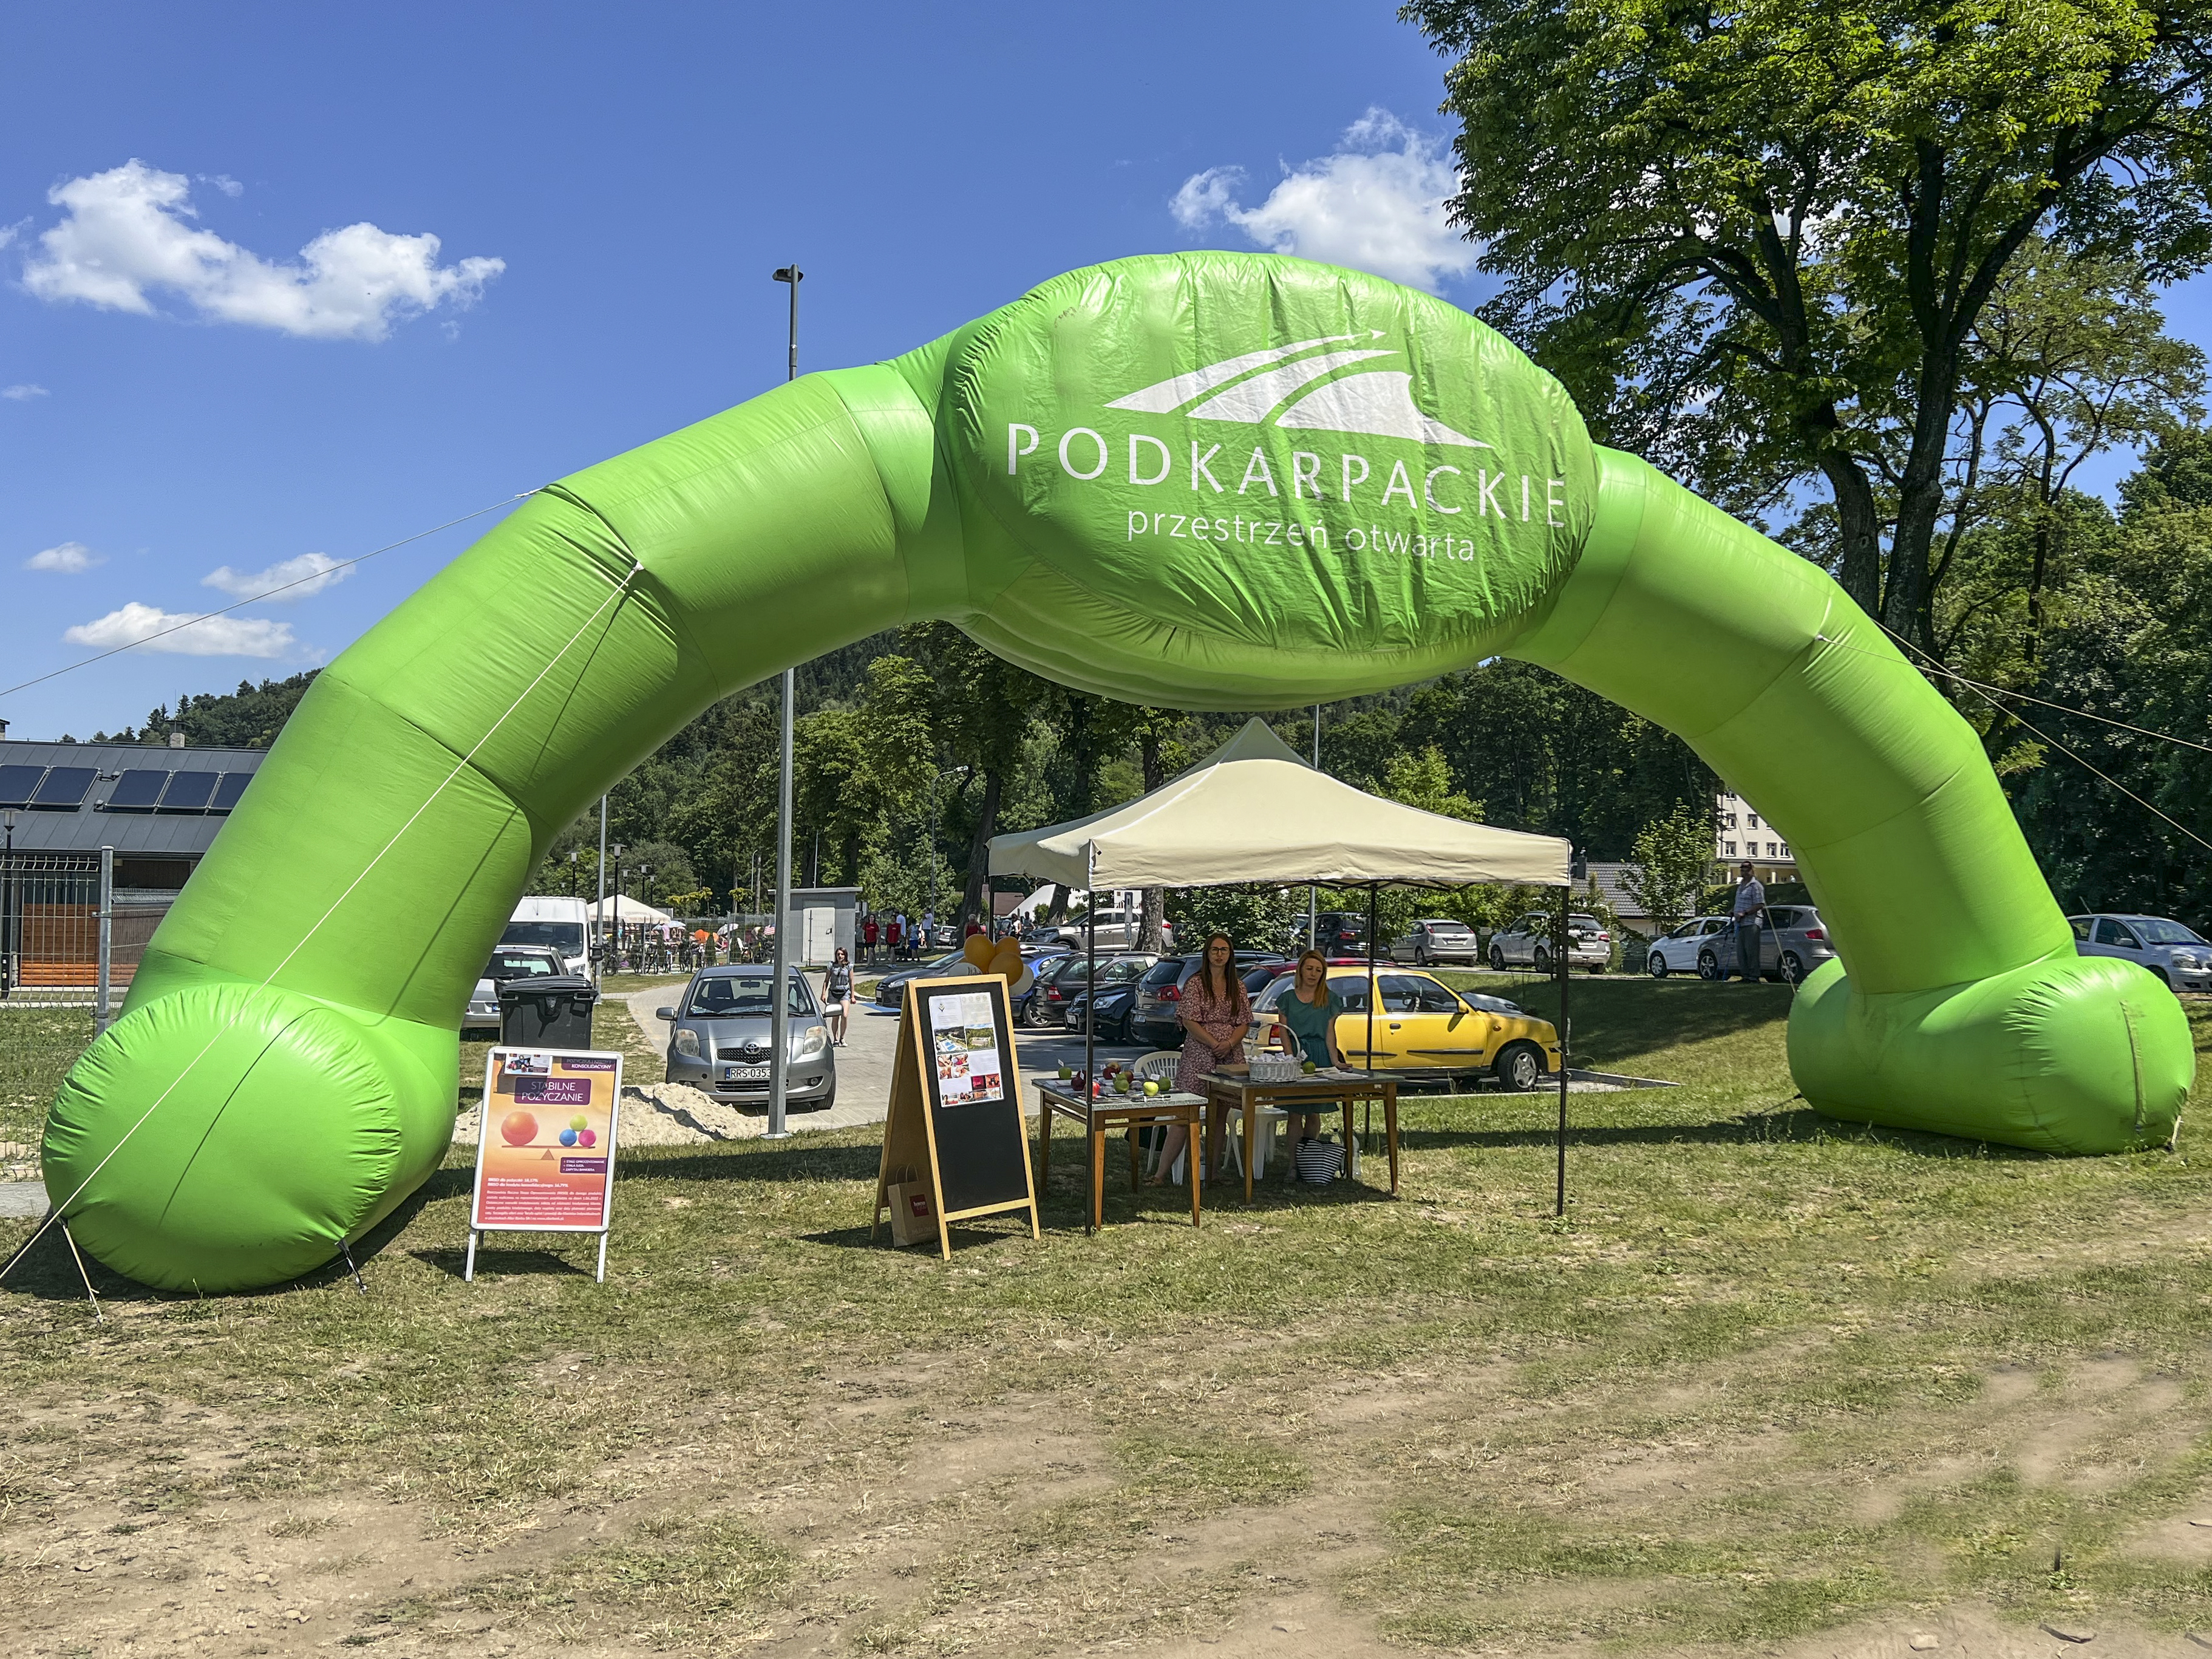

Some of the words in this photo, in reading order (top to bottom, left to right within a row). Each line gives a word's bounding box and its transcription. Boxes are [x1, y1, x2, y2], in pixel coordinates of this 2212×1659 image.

[1007, 422, 1566, 529] PODKARPACKIE
[1128, 506, 1329, 549] przestrzeń
[1345, 526, 1475, 561] otwarta
[730, 1069, 747, 1077] RRS
[750, 1069, 771, 1077] 0353
[531, 1081, 576, 1091] STABILNE
[522, 1091, 584, 1102] POŻYCZANIE
